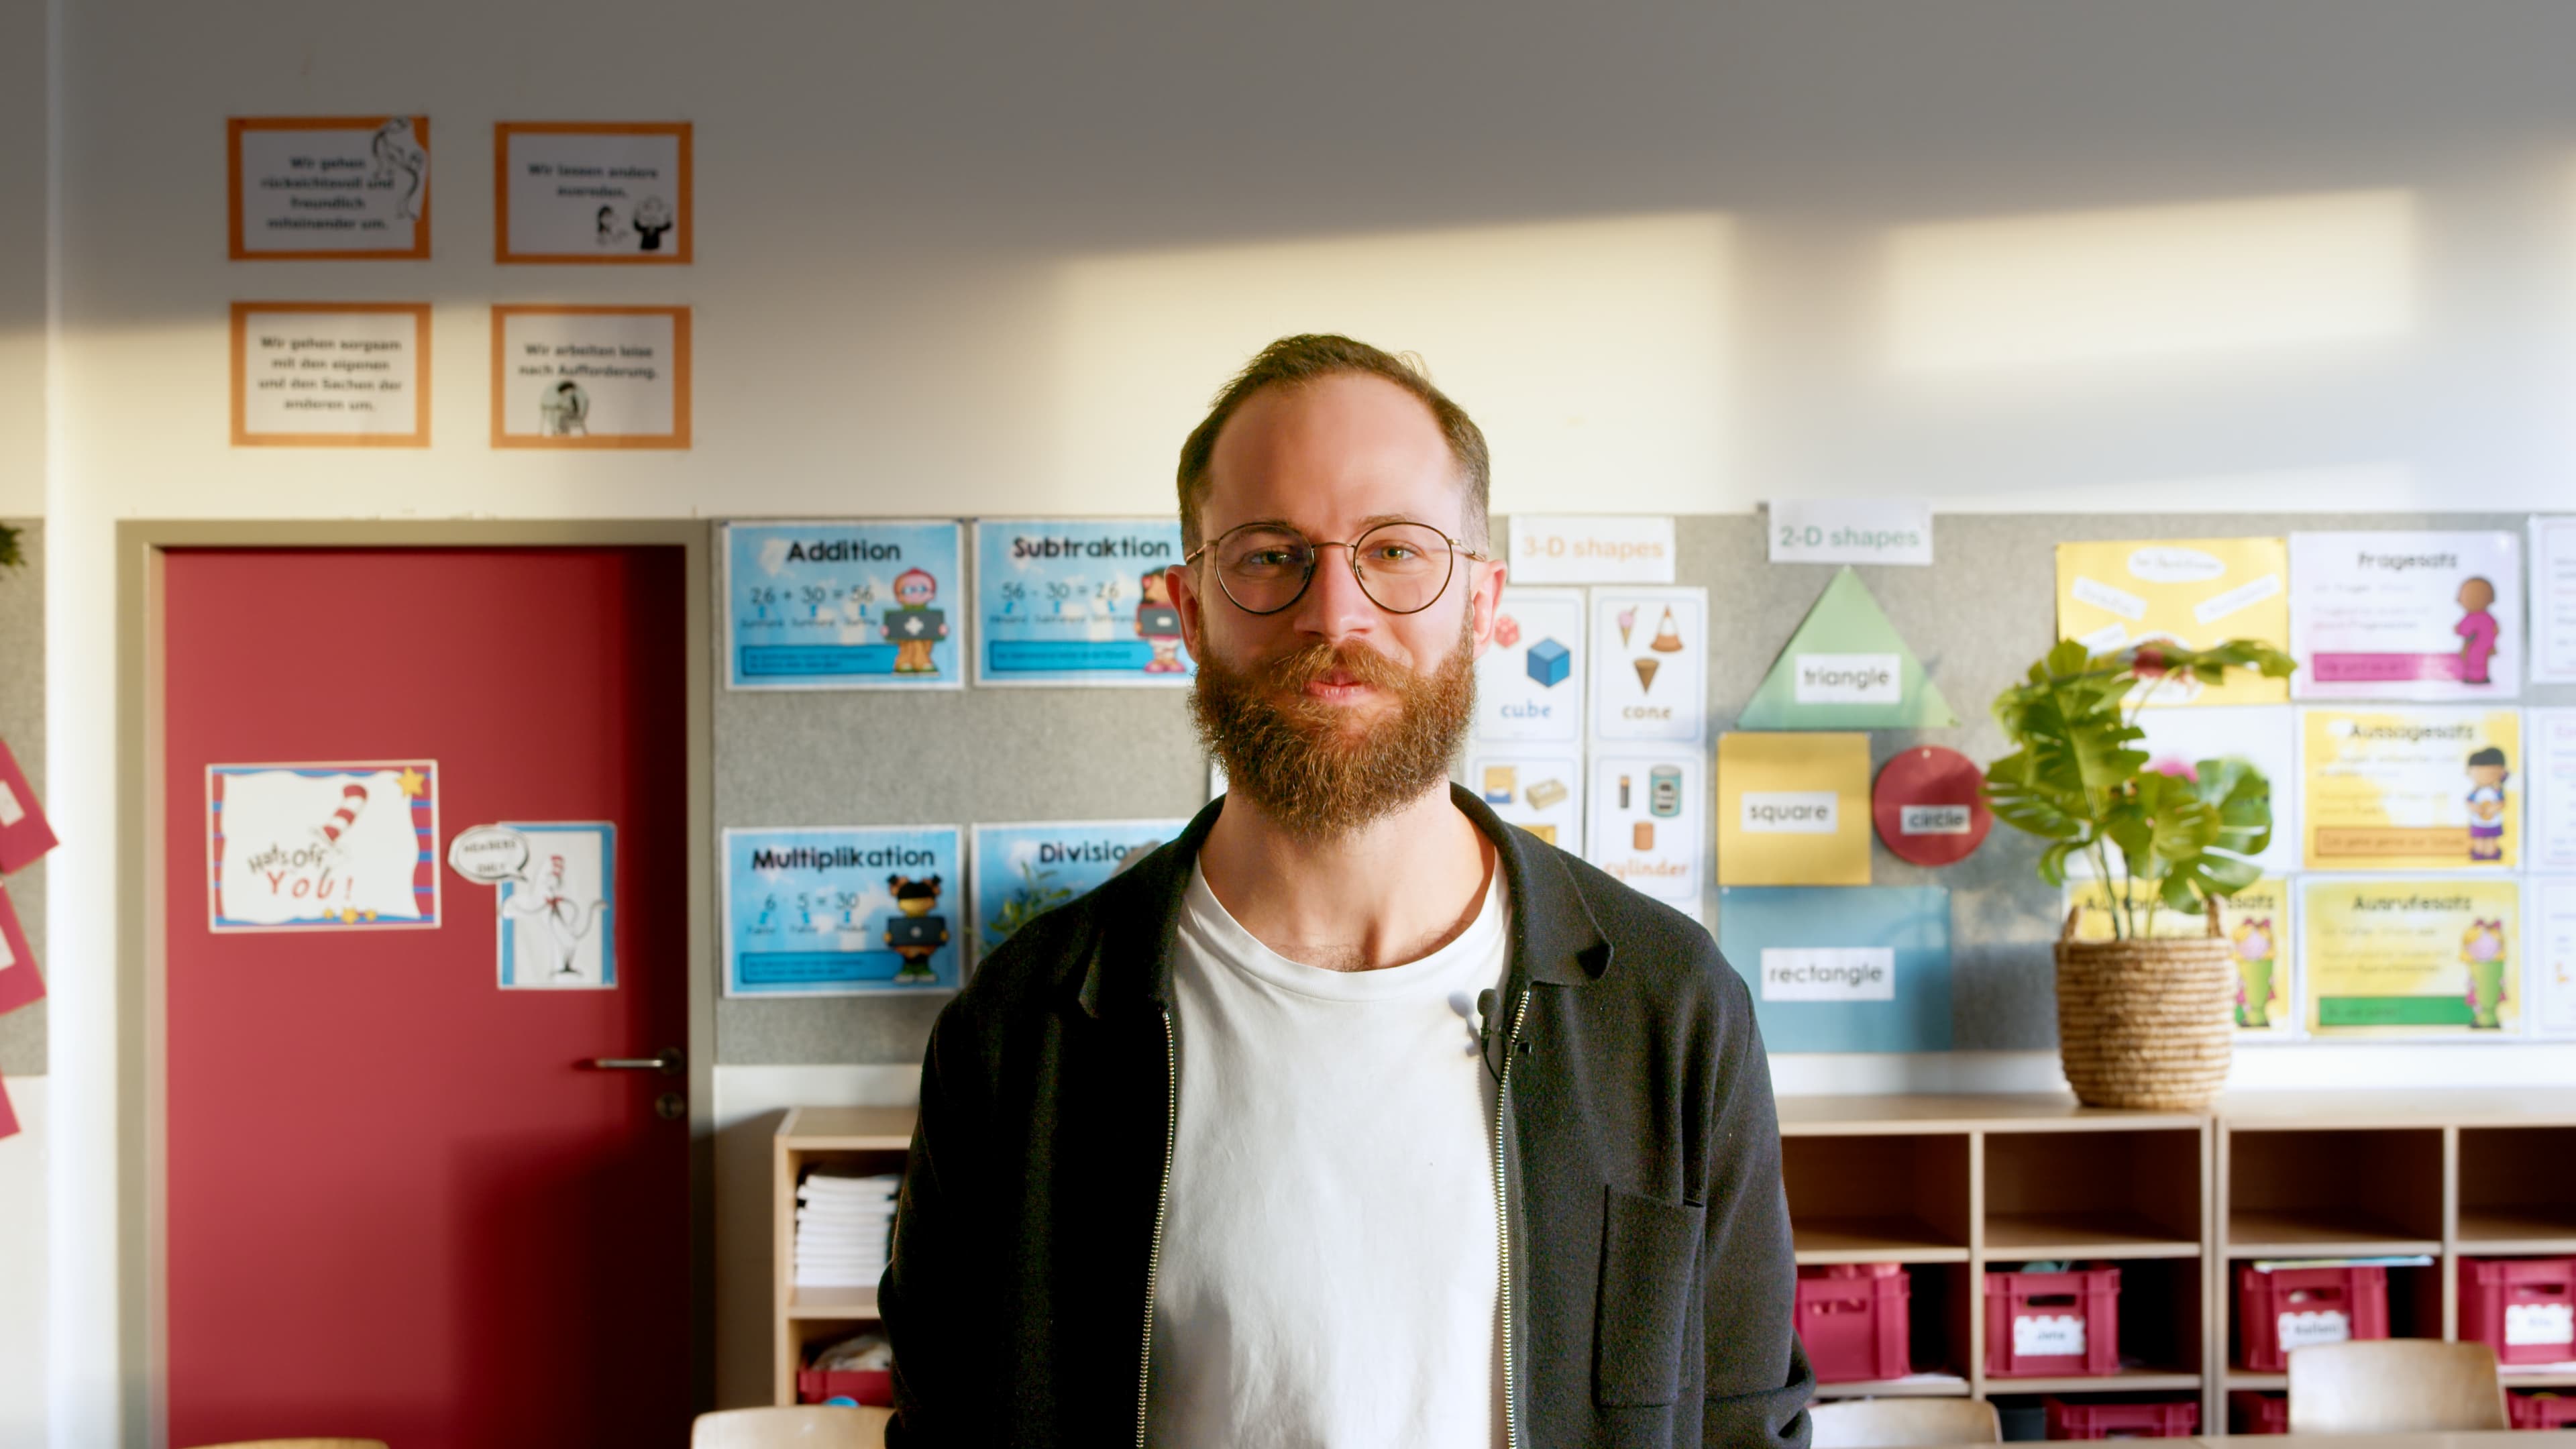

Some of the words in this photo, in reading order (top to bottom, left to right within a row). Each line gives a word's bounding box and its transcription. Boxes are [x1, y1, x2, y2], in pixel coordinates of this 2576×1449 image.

[1014, 537, 1171, 559] Subtraktion
[1780, 525, 1823, 548] 2-D
[1829, 526, 1920, 551] shapes
[786, 540, 901, 563] Addition
[1523, 535, 1566, 557] 3-D
[1573, 537, 1666, 563] shapes
[2358, 552, 2457, 572] Fragesatz
[751, 586, 776, 604] 26
[802, 586, 826, 604] 30
[850, 584, 874, 604] 56
[1003, 582, 1026, 600] 56
[1047, 582, 1071, 600] 30
[1095, 581, 1118, 600] 26
[1803, 669, 1890, 690] triangle
[1500, 700, 1552, 718] cube
[1622, 706, 1672, 720] cone
[2349, 724, 2473, 743] Aussagesatz
[1750, 805, 1829, 823] square
[1909, 812, 1966, 828] circle
[751, 846, 934, 873] Multiplikation
[1039, 842, 1139, 863] Divisio
[1602, 858, 1688, 879] cylinder
[765, 894, 777, 912] 6
[798, 892, 810, 910] 5
[835, 892, 859, 910] 30
[2353, 896, 2471, 911] Ausrufesatz
[1768, 963, 1885, 986] rectangle
